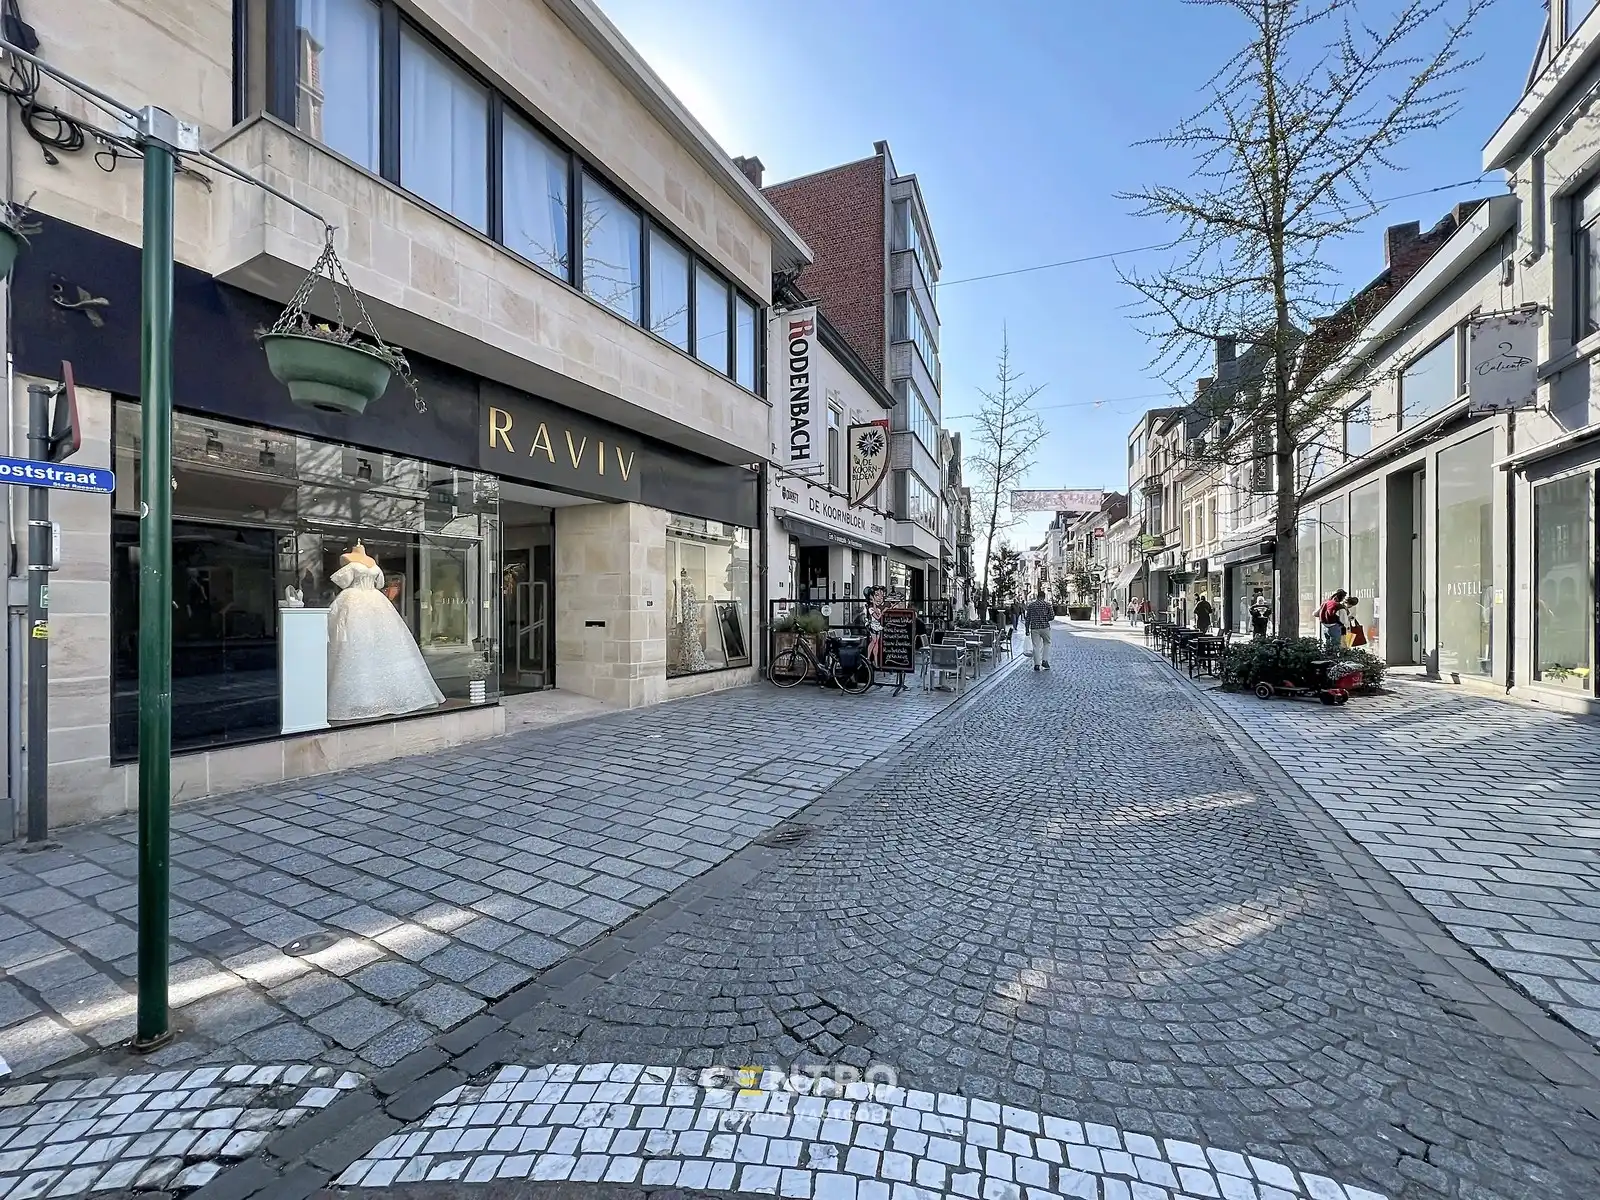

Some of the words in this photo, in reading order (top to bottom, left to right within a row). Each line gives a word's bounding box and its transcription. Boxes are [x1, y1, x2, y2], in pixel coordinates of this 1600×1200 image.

[788, 316, 815, 461] RODENBACH
[489, 406, 635, 482] RAVIV
[862, 458, 873, 466] DE
[0, 464, 98, 485] oststraat
[852, 473, 875, 481] BLOEM
[809, 497, 821, 514] DE
[823, 502, 866, 531] KOORNBLOEM
[1447, 580, 1483, 596] PASTELL
